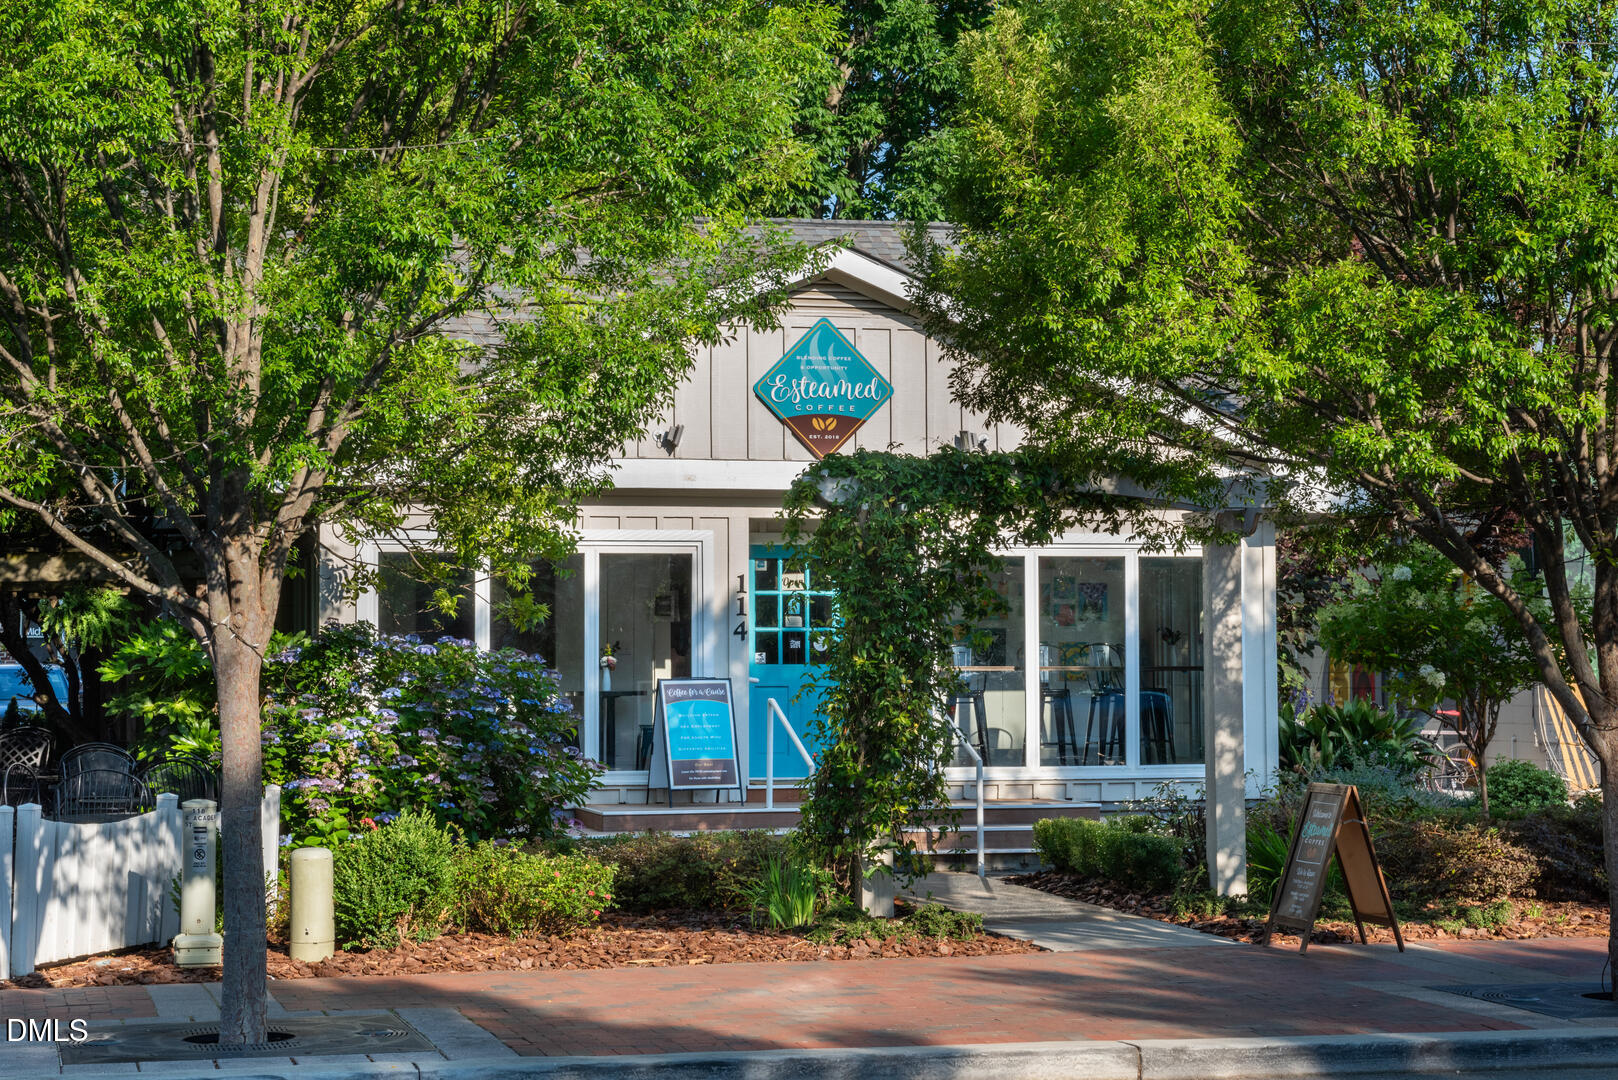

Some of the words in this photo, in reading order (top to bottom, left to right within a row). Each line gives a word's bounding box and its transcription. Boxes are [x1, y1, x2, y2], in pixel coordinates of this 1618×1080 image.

[767, 374, 882, 404] Esteamed
[795, 404, 856, 412] COFFEE
[667, 688, 687, 697] Coffee
[688, 688, 698, 697] for
[704, 688, 726, 696] Cause
